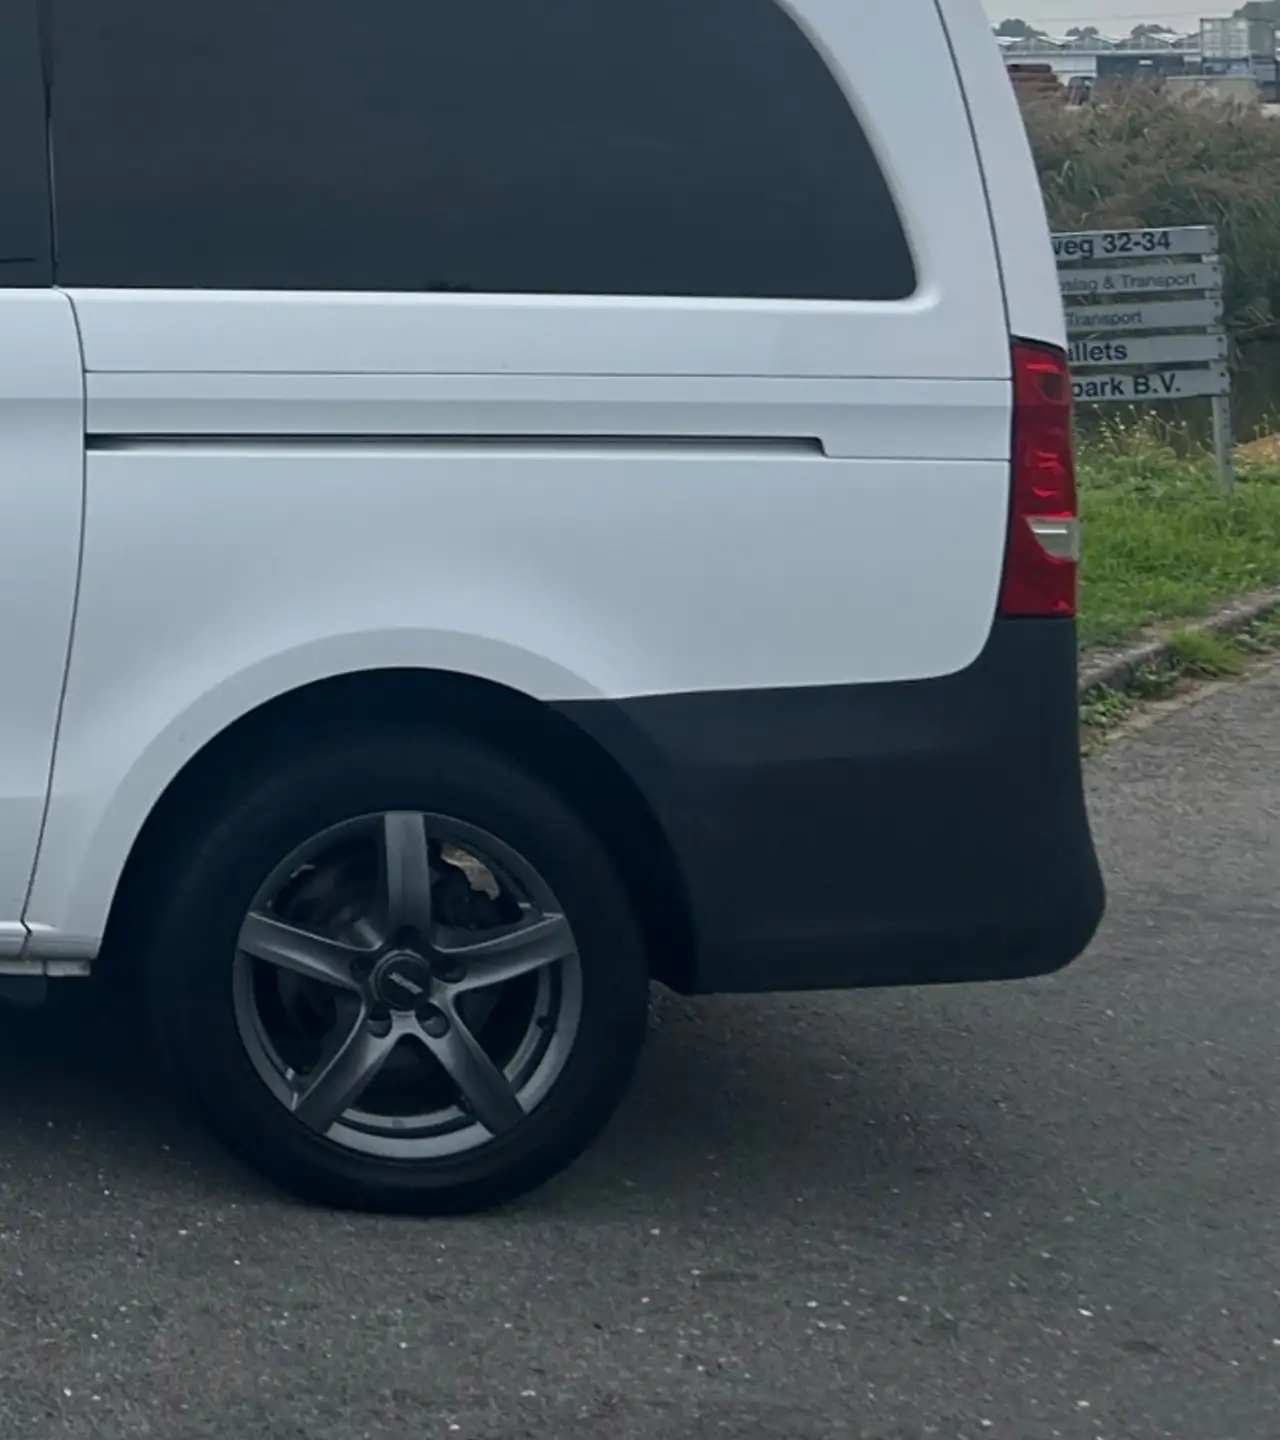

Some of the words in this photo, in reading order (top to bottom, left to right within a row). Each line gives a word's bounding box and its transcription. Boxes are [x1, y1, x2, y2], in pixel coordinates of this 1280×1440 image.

[1102, 231, 1172, 254] 32-34
[1121, 271, 1198, 290] Transport
[1133, 372, 1182, 396] B.V.
